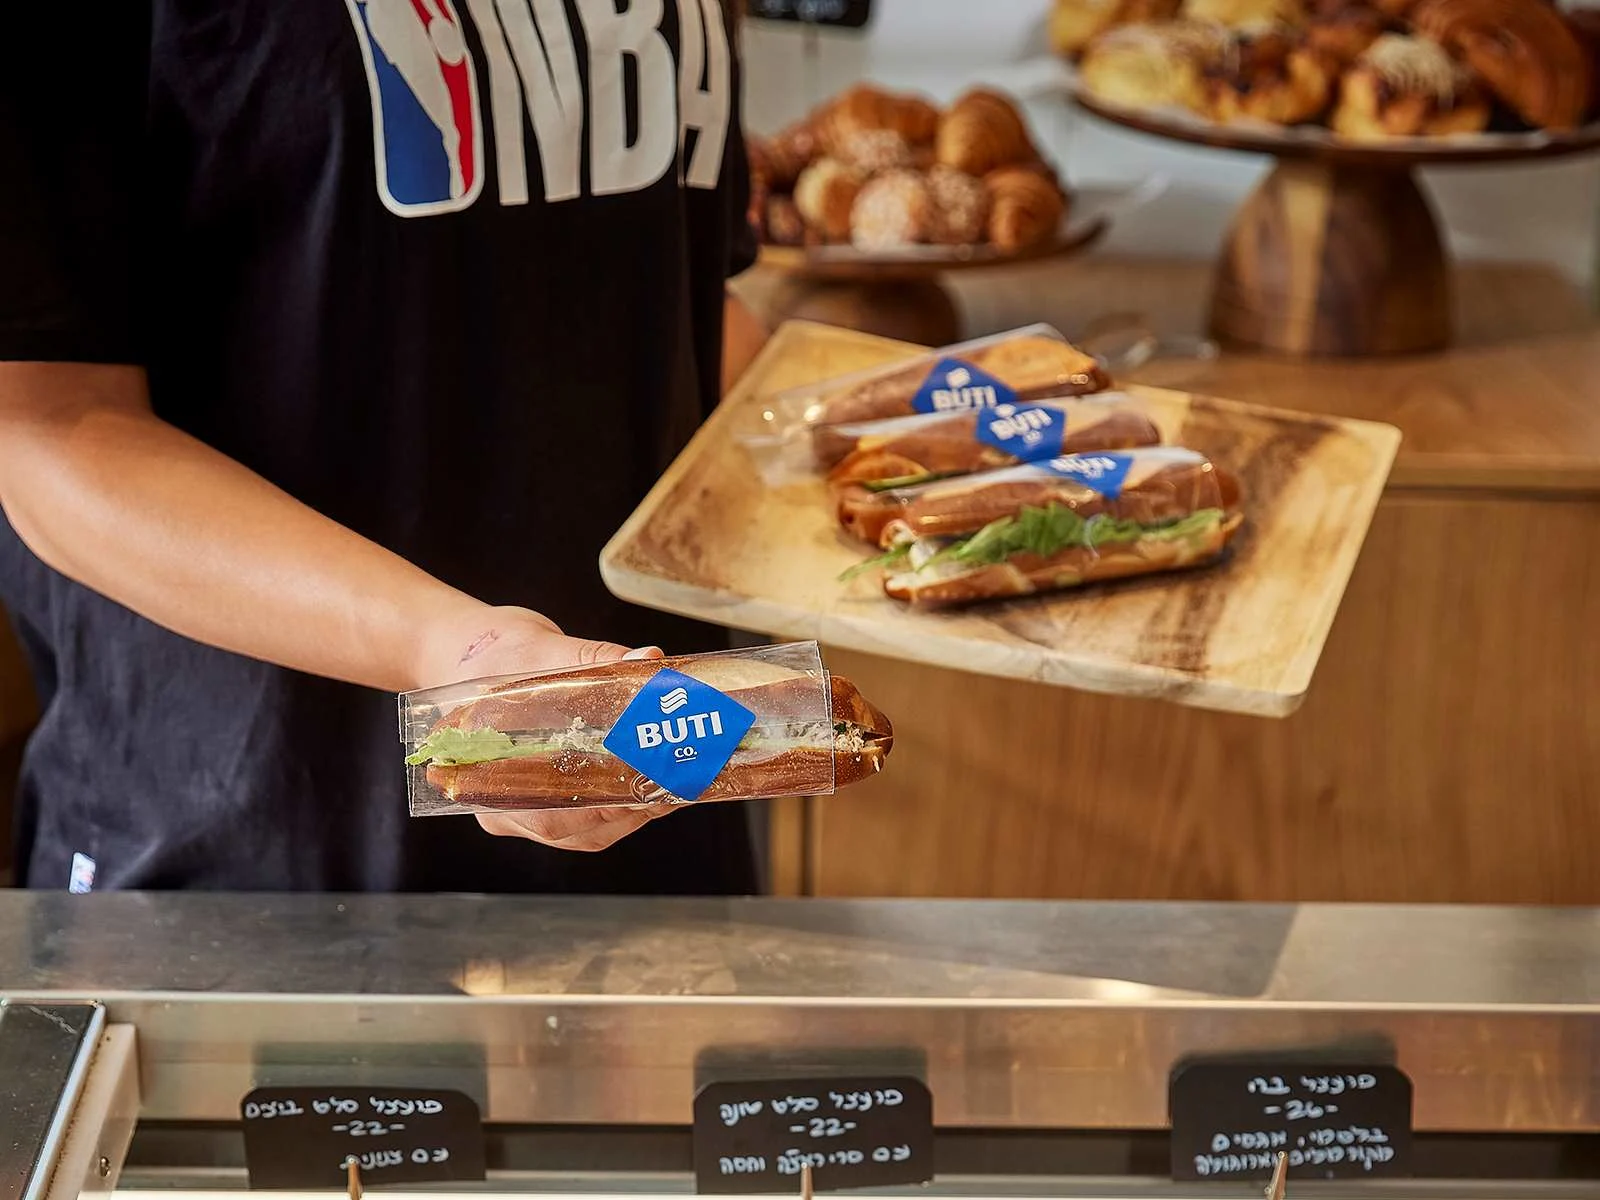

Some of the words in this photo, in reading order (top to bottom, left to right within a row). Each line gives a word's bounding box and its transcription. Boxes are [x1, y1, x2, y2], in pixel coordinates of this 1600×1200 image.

[467, 0, 731, 206] NBA
[932, 385, 997, 410] BUTI
[990, 408, 1052, 440] BUTI
[636, 711, 723, 749] BUTI
[674, 746, 698, 758] CO.
[312, 1097, 359, 1113] סלט
[369, 1096, 443, 1115] פרעצל
[771, 1096, 819, 1114] סלט
[829, 1089, 904, 1111] פרעצל
[720, 1101, 763, 1126] טונה
[411, 1147, 449, 1163] עם
[872, 1145, 911, 1161] עם
